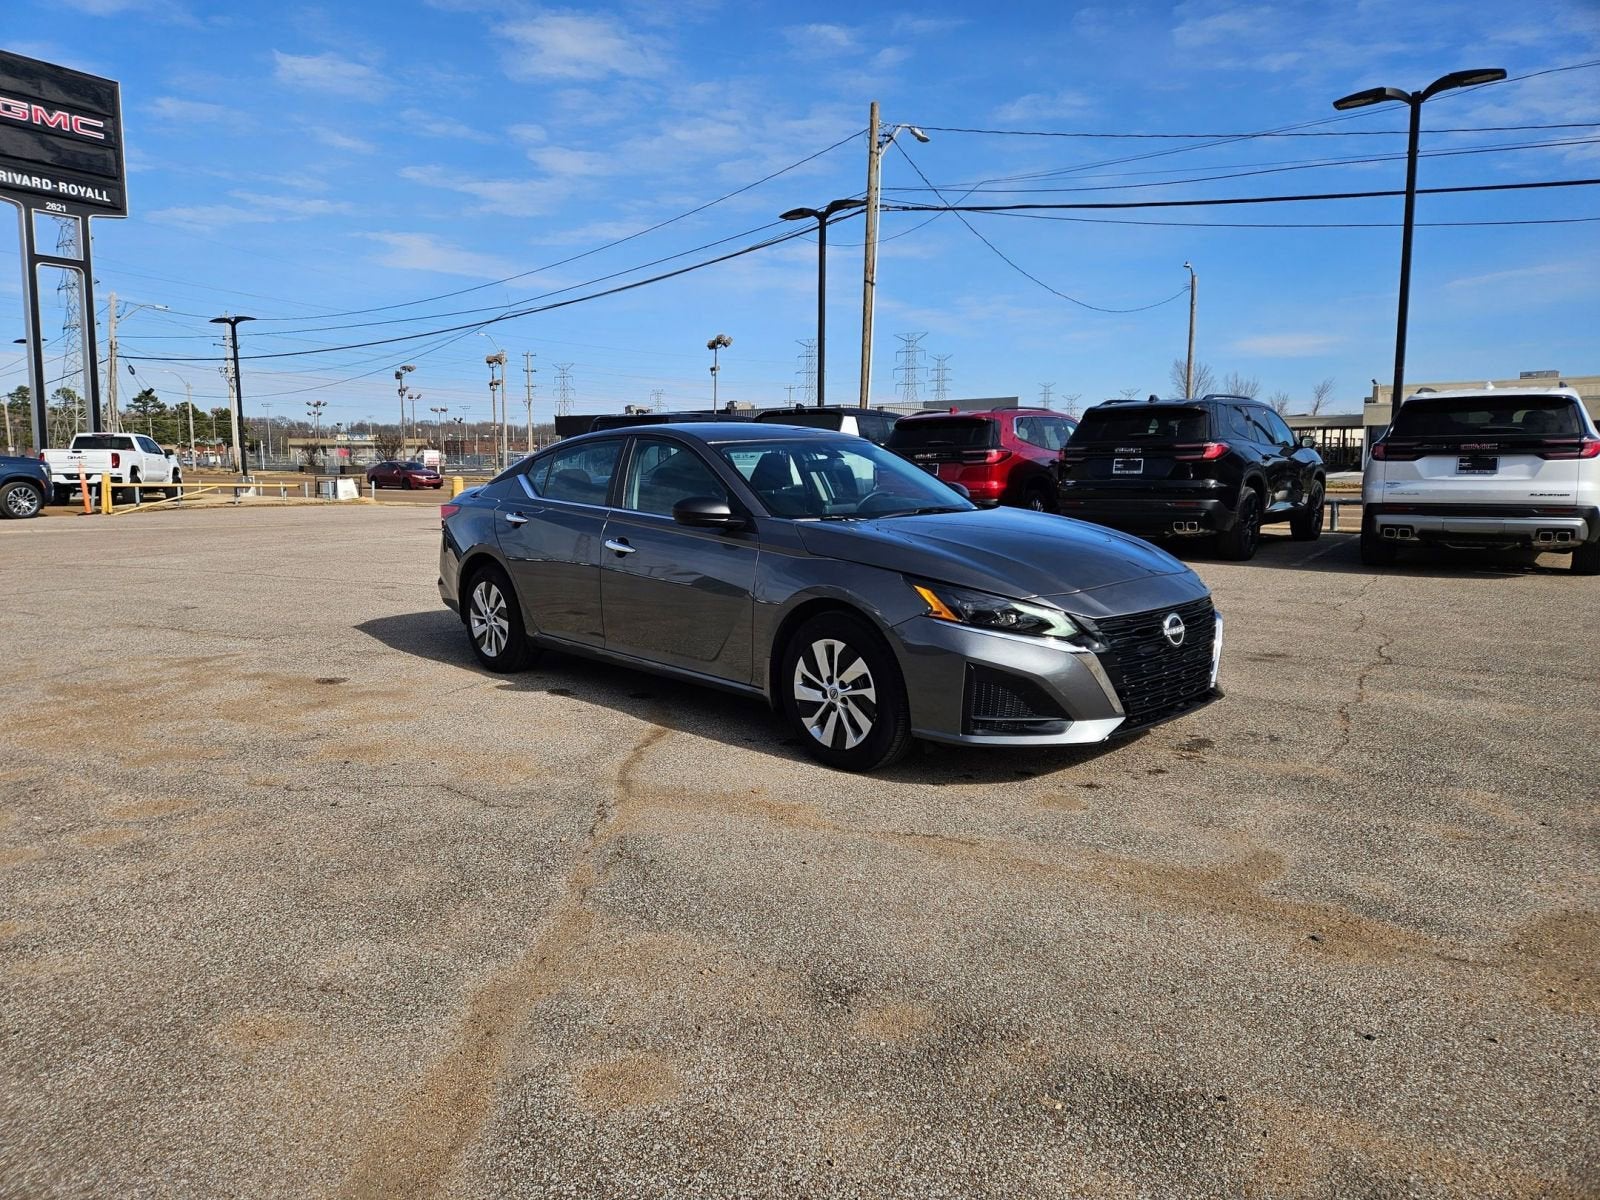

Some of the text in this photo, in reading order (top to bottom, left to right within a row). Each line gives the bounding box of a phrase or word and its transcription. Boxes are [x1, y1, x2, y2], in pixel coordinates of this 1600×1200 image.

[0, 97, 105, 140] GMC
[0, 170, 111, 202] RIVARD-ROYALL
[45, 201, 67, 212] 2621
